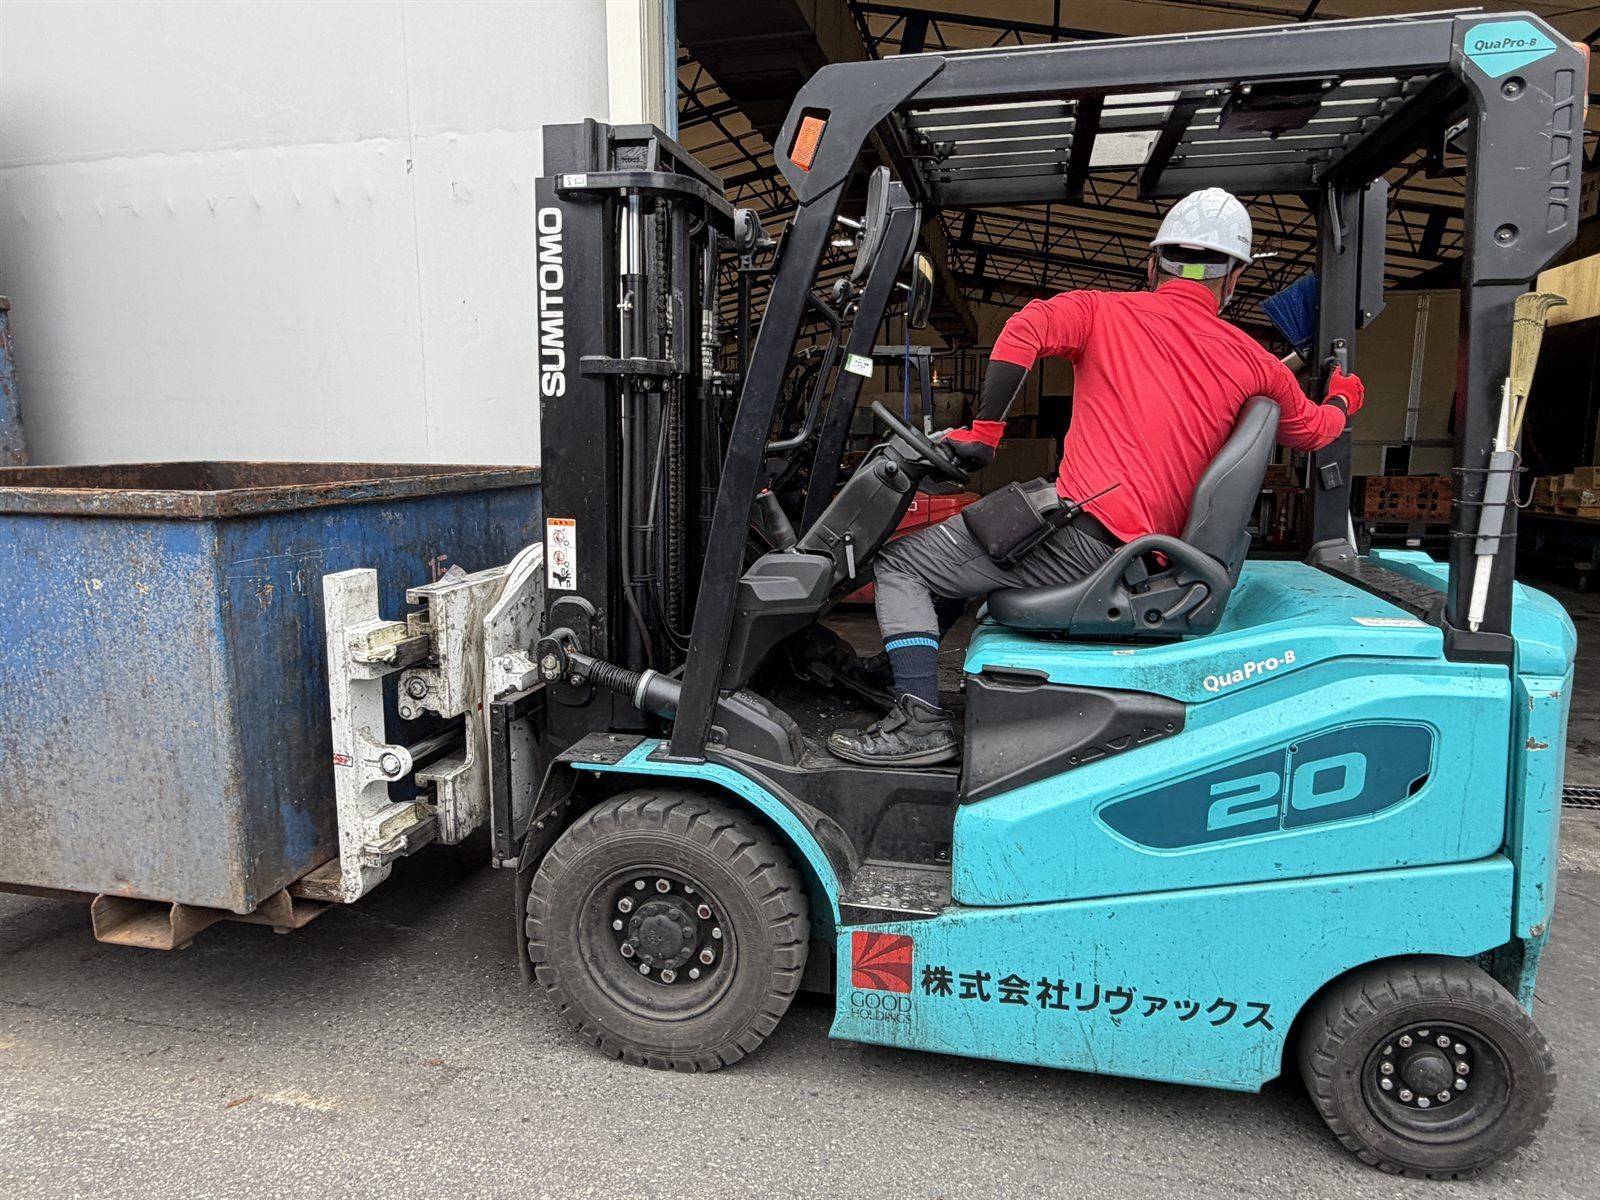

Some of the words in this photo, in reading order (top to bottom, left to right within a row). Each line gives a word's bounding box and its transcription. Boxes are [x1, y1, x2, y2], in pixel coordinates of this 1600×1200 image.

[1474, 38, 1537, 51] QuaPro-B
[538, 207, 566, 397] SUMITOMO
[1203, 650, 1296, 692] QuaPro-B
[1207, 752, 1367, 831] 20
[850, 991, 912, 1012] GOOD
[921, 964, 1274, 1031] 株式会社リヴァックス
